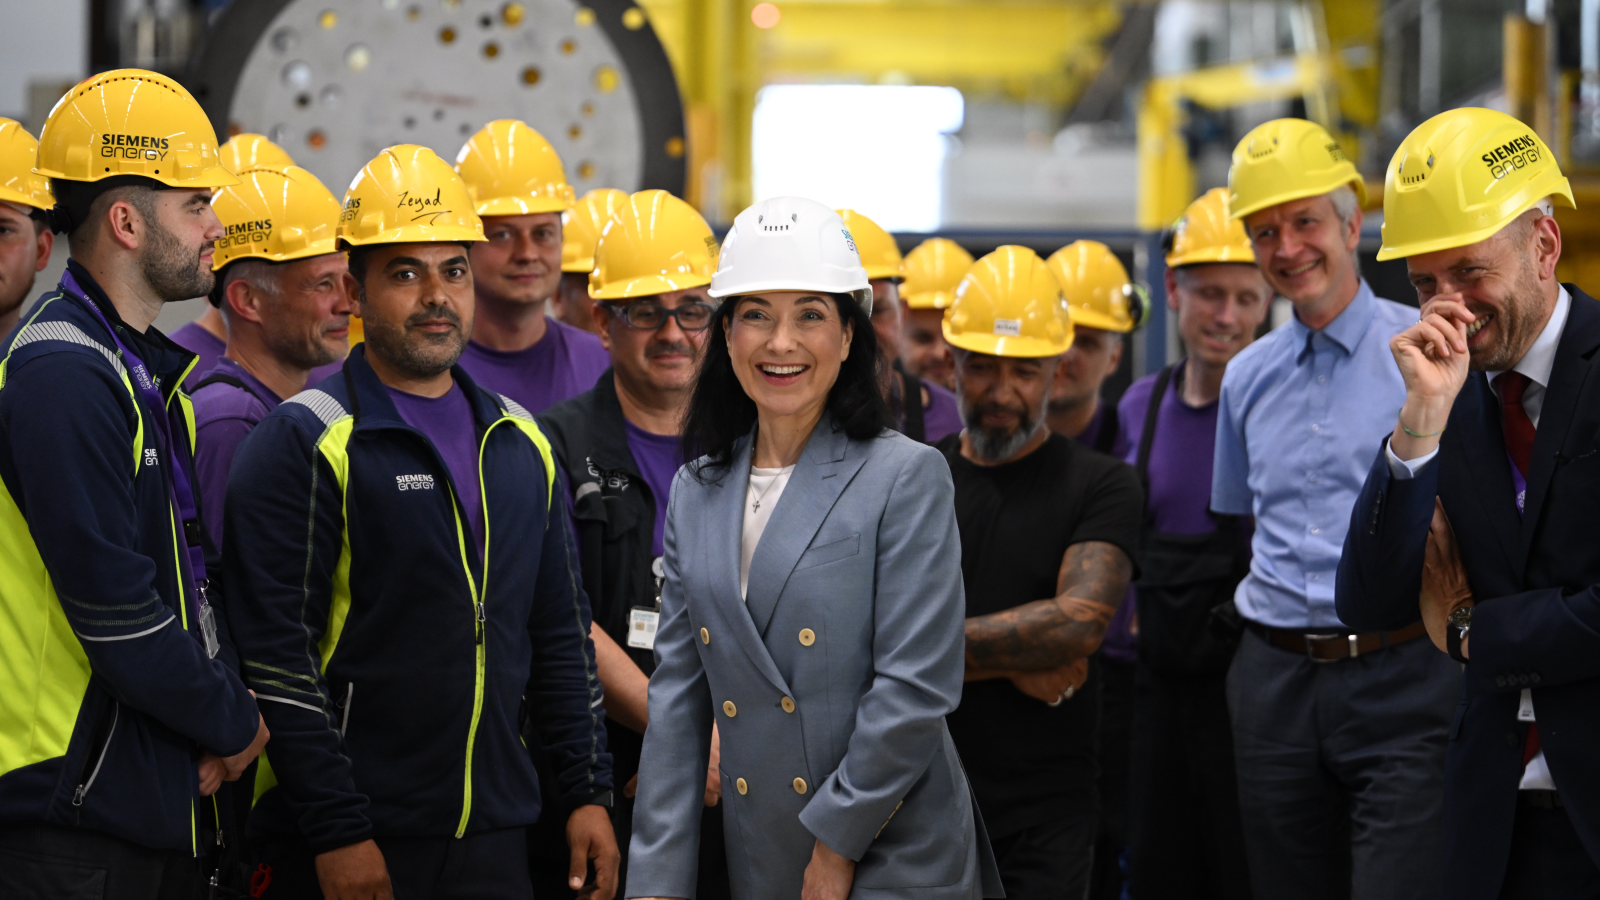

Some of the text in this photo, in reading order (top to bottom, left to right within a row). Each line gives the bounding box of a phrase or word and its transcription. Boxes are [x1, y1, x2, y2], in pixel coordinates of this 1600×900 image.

[102, 134, 169, 149] SIEMENS
[1482, 135, 1535, 167] SIEMENS
[398, 187, 442, 213] Zeyad
[225, 219, 272, 236] IEMENS
[396, 474, 434, 484] SIEMENS
